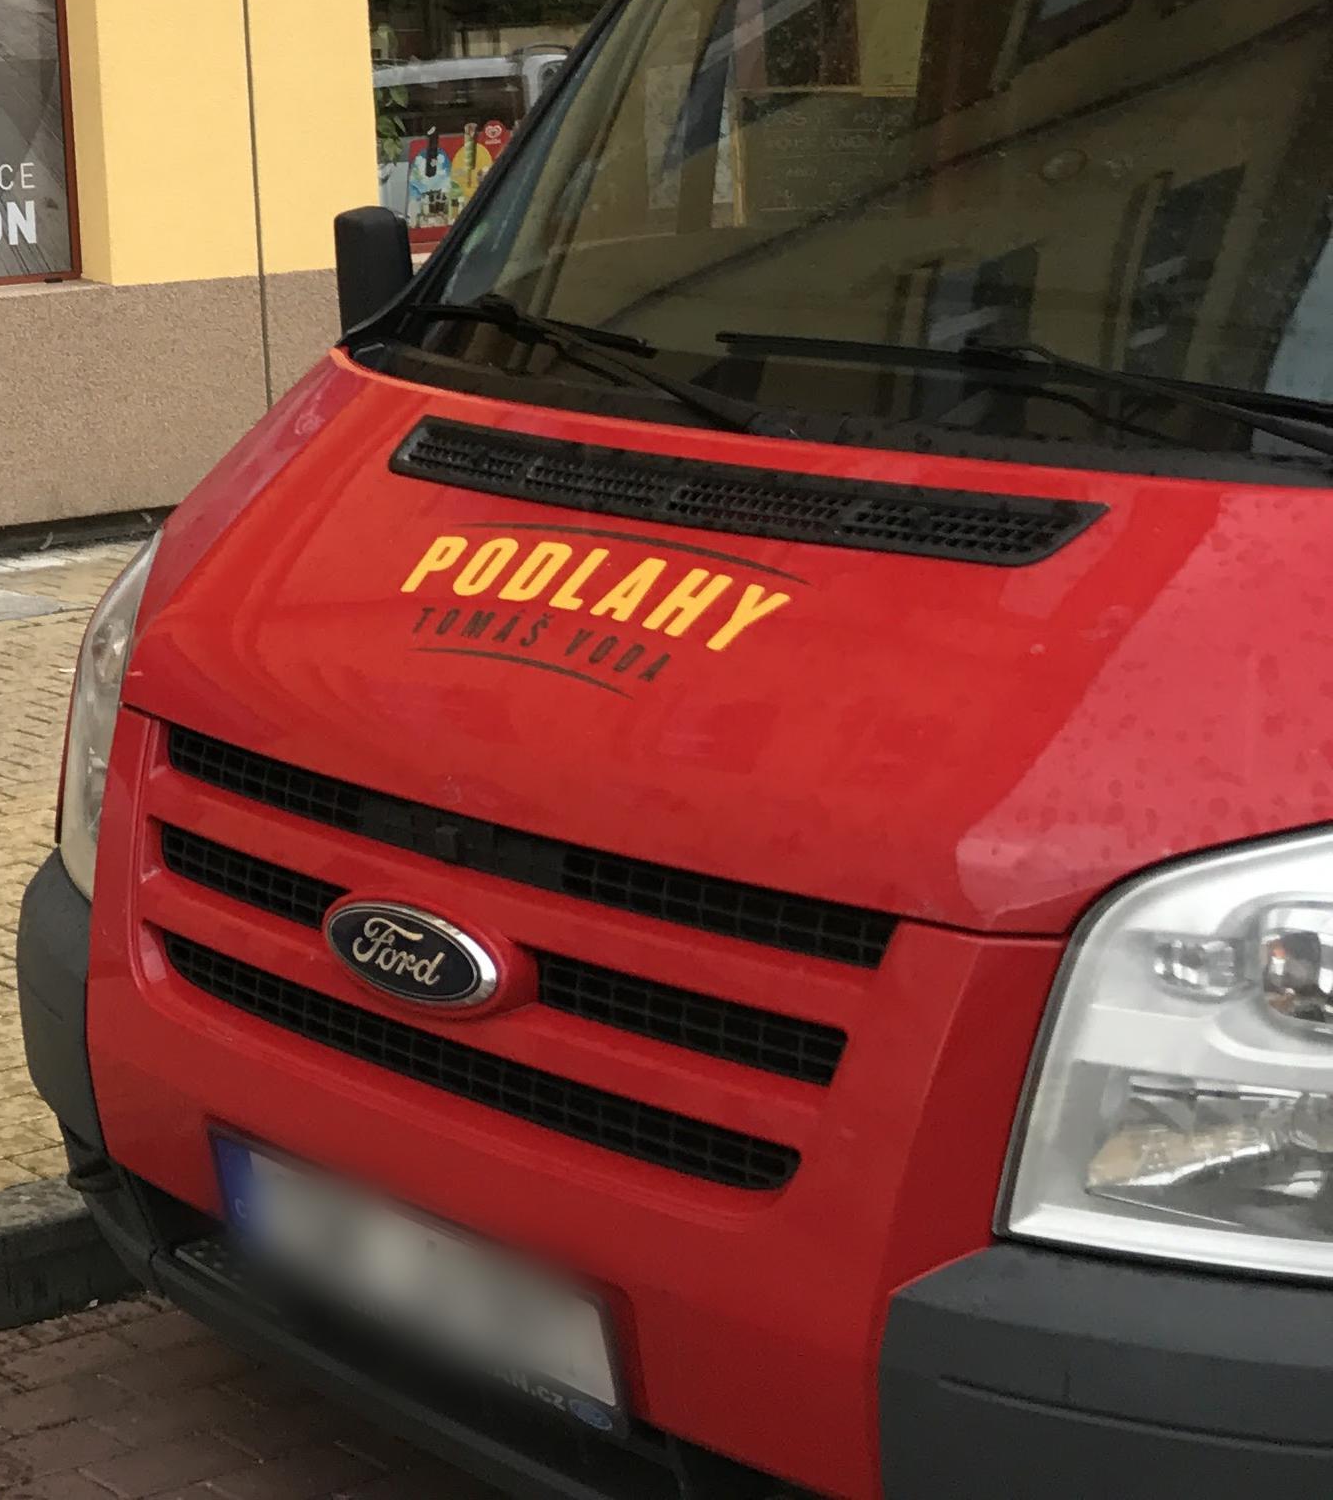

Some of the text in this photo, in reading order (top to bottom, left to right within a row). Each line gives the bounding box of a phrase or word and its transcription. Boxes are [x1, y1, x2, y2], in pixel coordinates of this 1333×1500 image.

[399, 536, 792, 652] PODLAHY
[411, 606, 672, 683] TOMÁŠ VODA
[352, 917, 445, 986] Ford
